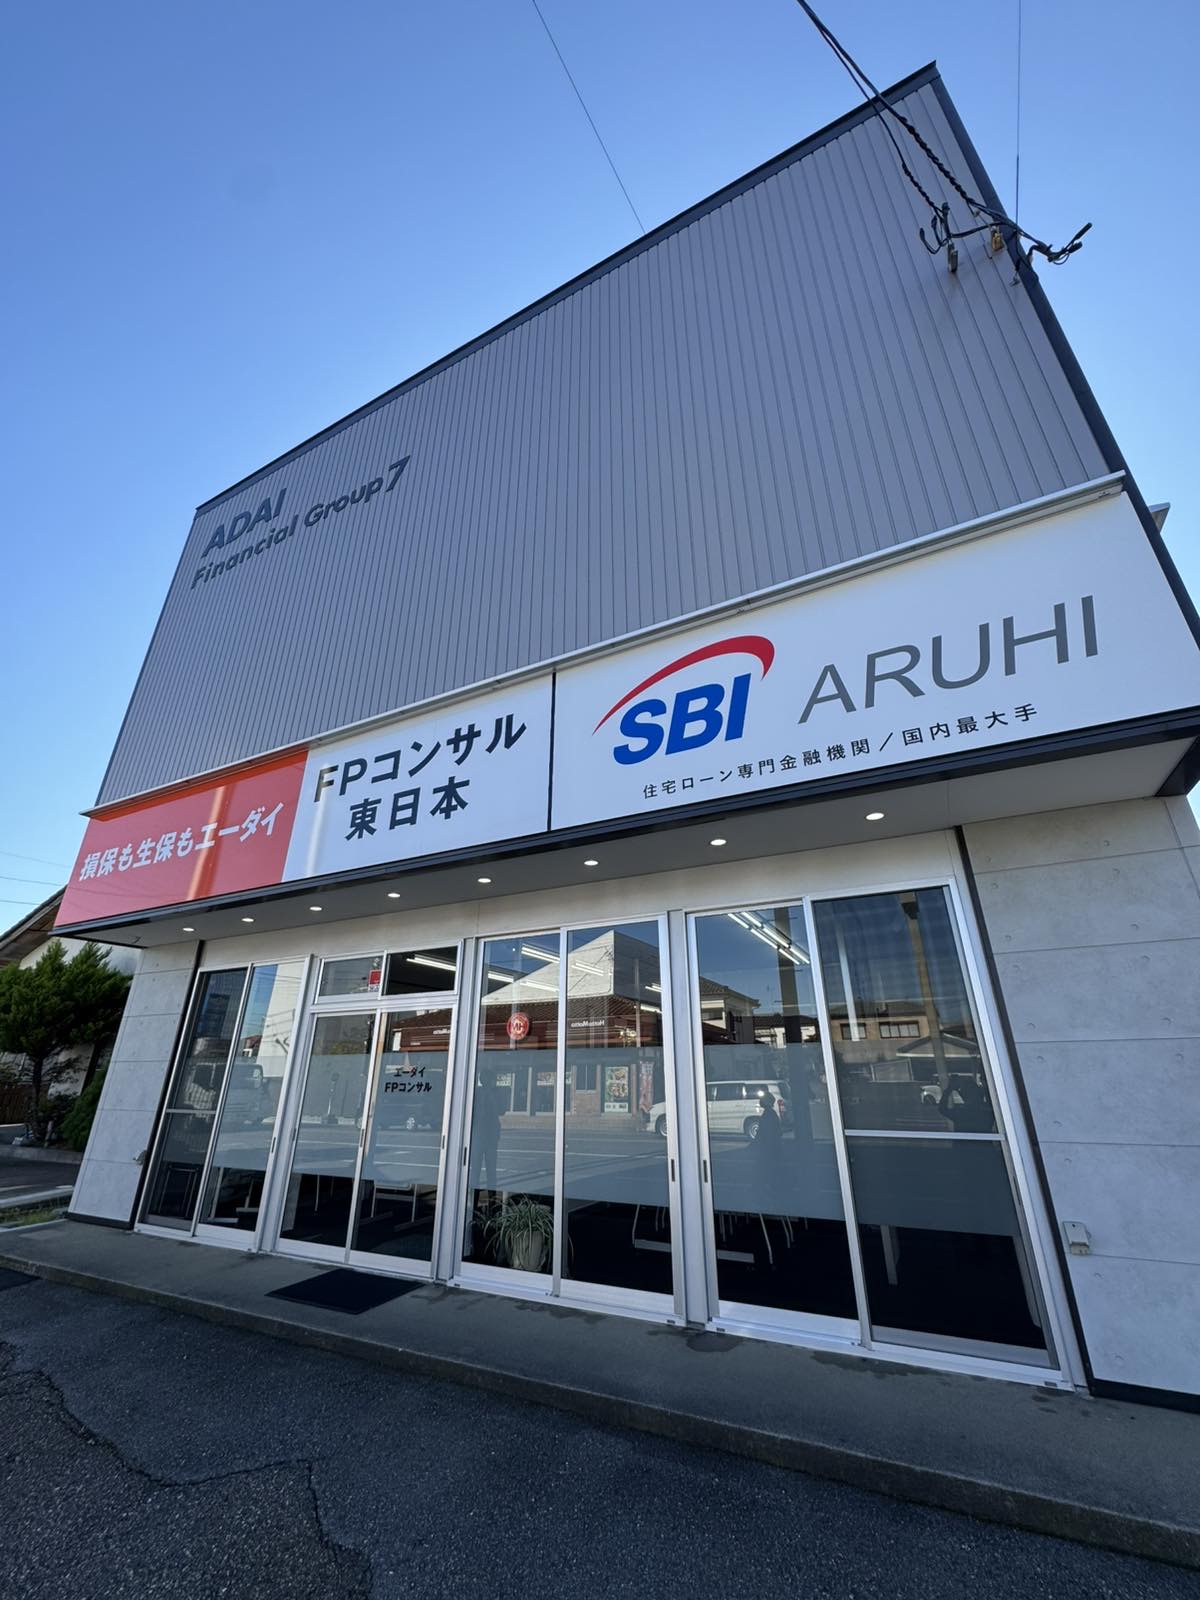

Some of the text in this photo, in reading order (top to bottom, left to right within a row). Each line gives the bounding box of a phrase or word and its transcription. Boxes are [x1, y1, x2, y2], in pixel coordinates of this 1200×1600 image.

[190, 514, 300, 590] Financial
[201, 487, 287, 559] ADAI
[798, 595, 1099, 725] ARUHI
[613, 672, 752, 766] SBI
[313, 713, 528, 803] FPコンサル
[79, 802, 285, 881] 損保も生保もエーダイ
[345, 776, 471, 841] 東日本
[384, 1081, 433, 1093] FPコンサル
